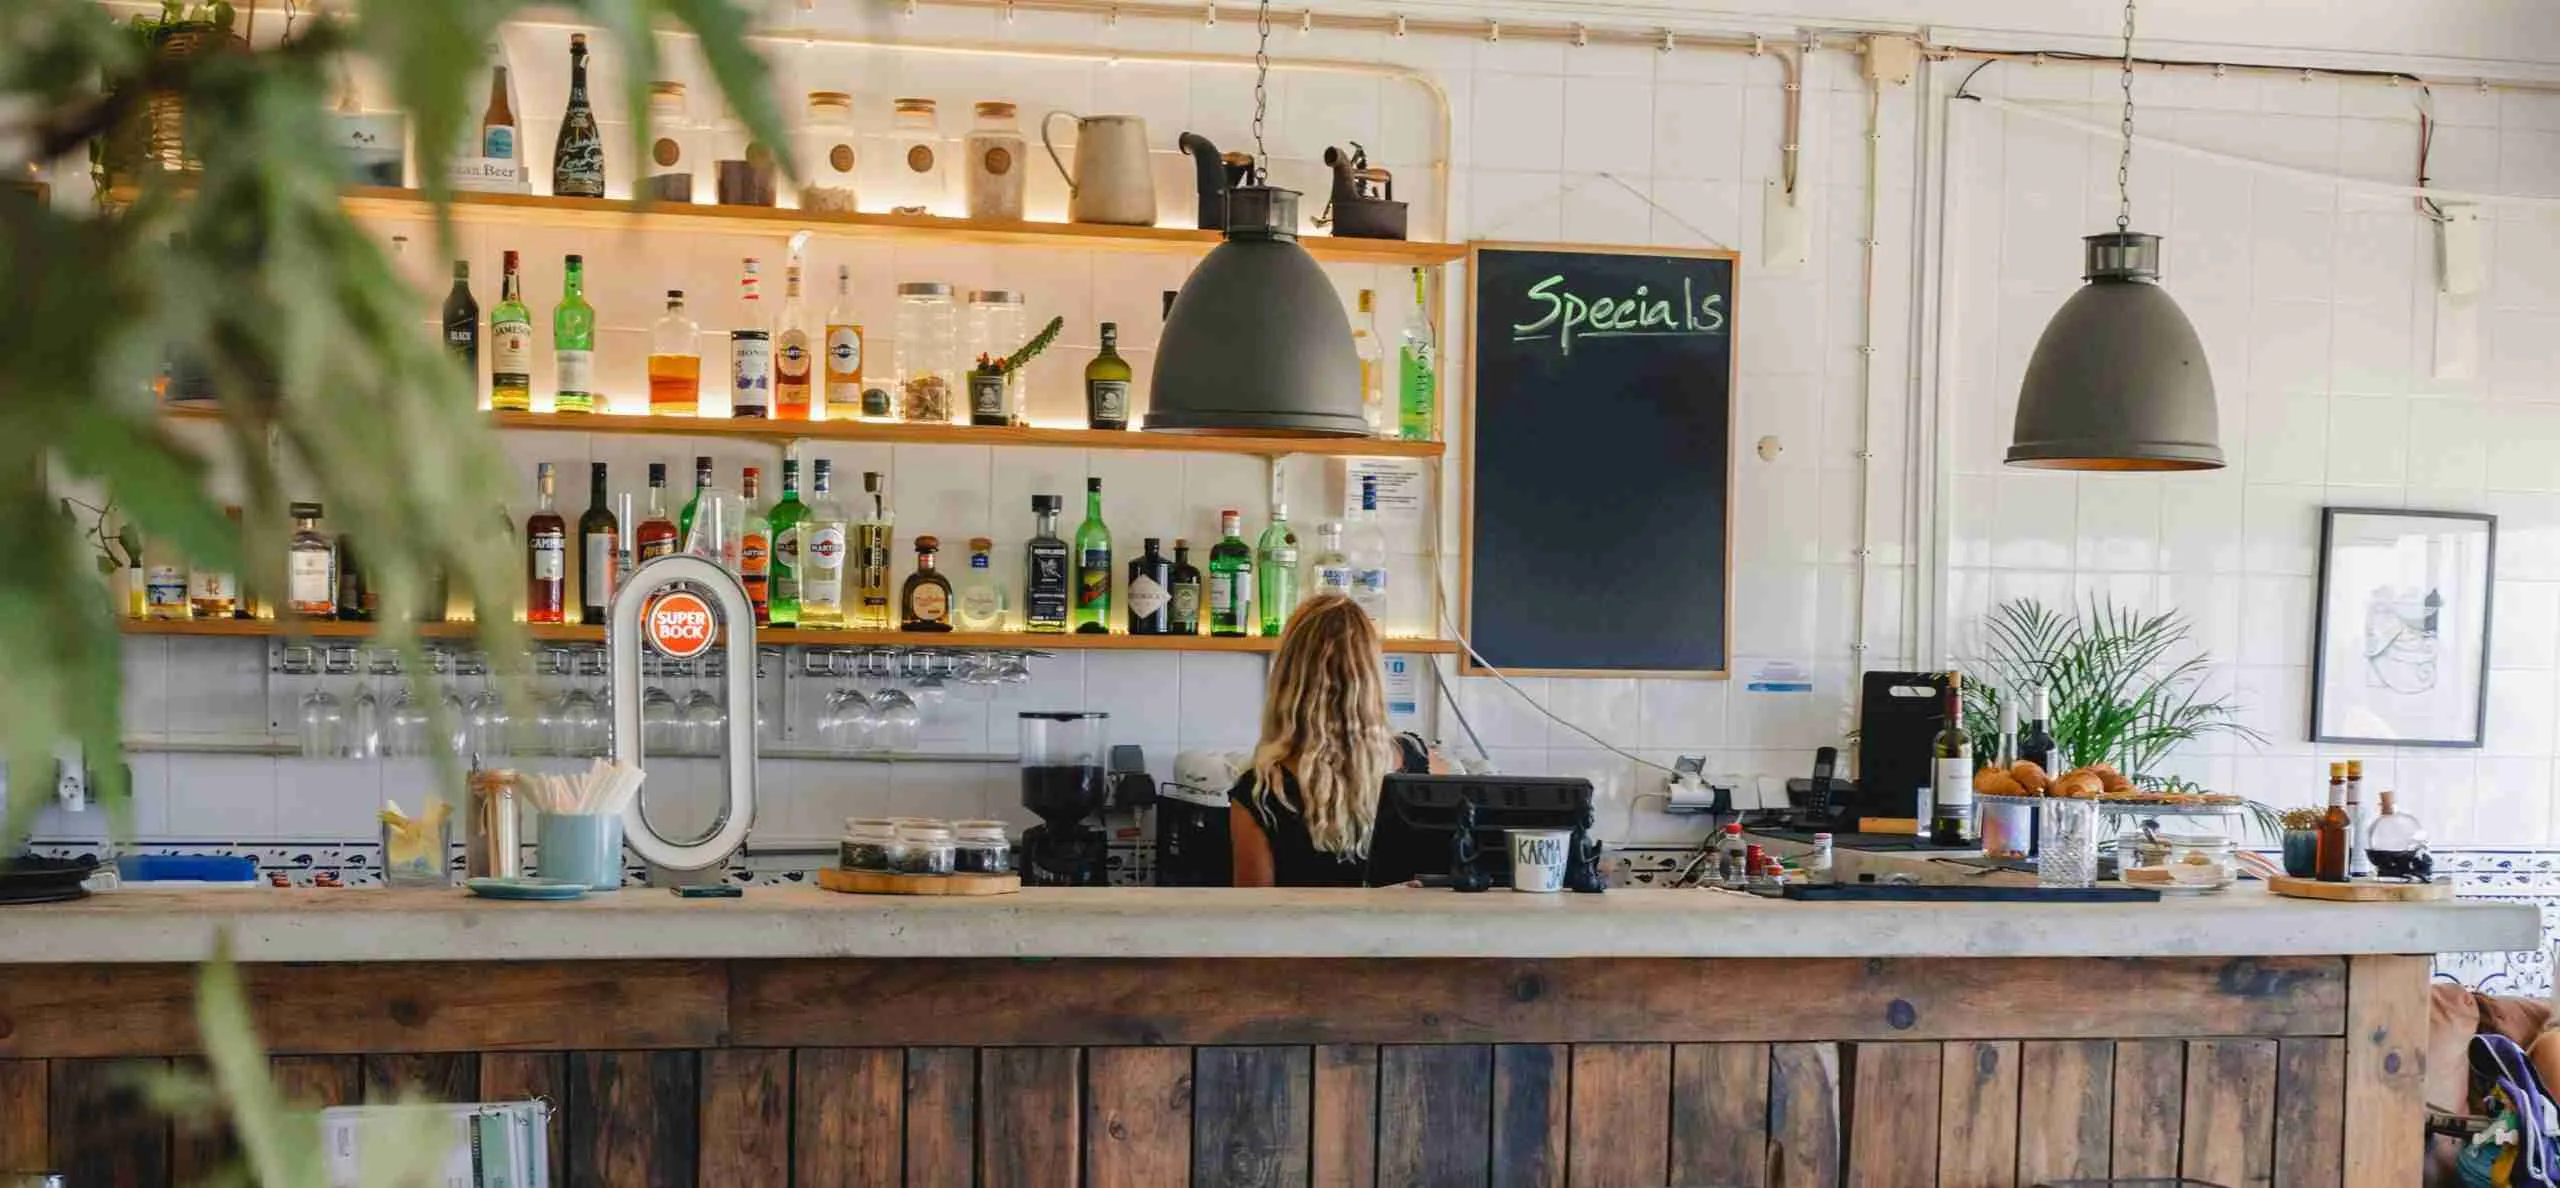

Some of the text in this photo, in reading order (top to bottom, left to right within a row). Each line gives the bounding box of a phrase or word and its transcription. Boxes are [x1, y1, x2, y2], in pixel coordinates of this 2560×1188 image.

[484, 164, 514, 177] Beer
[1514, 274, 1724, 356] Specials
[656, 611, 705, 625] SUPER
[659, 624, 705, 640] BOCK
[1518, 838, 1561, 865] KARMA
